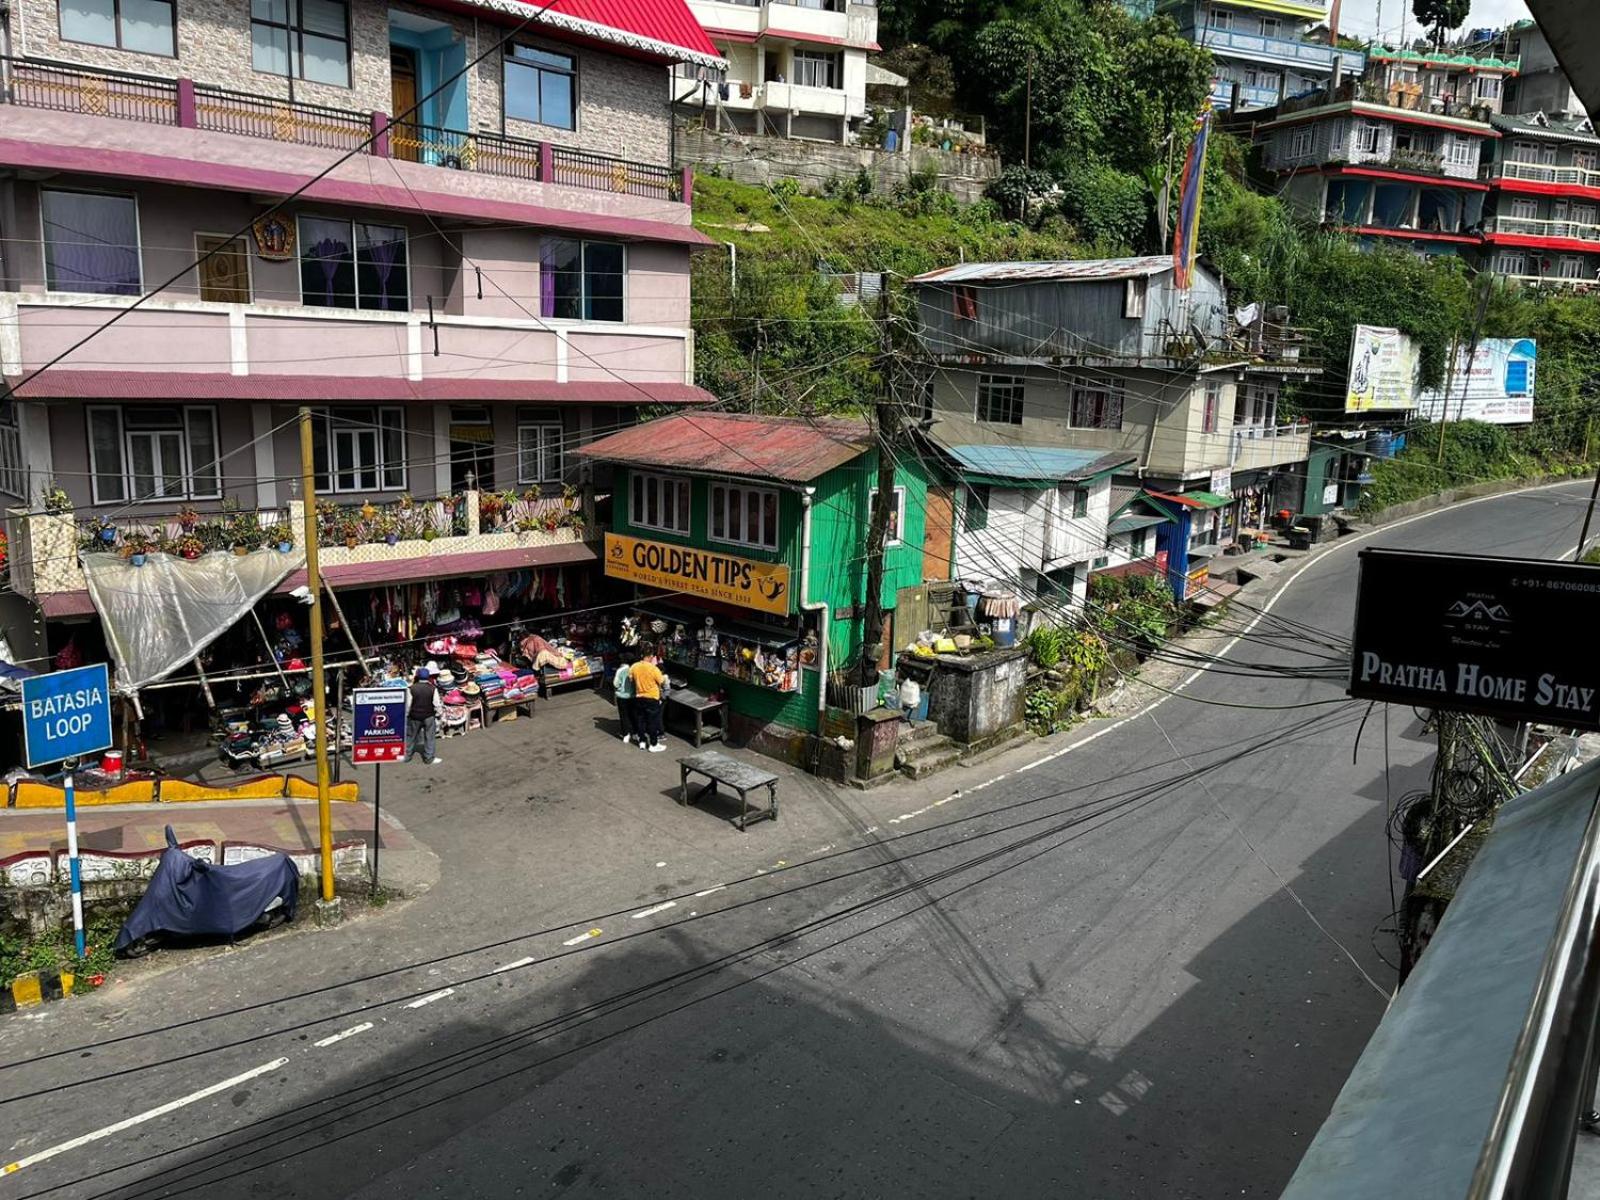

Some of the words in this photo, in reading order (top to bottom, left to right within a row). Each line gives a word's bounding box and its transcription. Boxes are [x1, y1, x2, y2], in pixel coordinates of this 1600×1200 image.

[633, 542, 708, 581] GOLDEN
[711, 557, 752, 590] TIPS
[710, 587, 732, 600] SINCE
[31, 687, 103, 719] BATASIA
[46, 713, 92, 740] LOOP
[364, 728, 395, 736] PARKING
